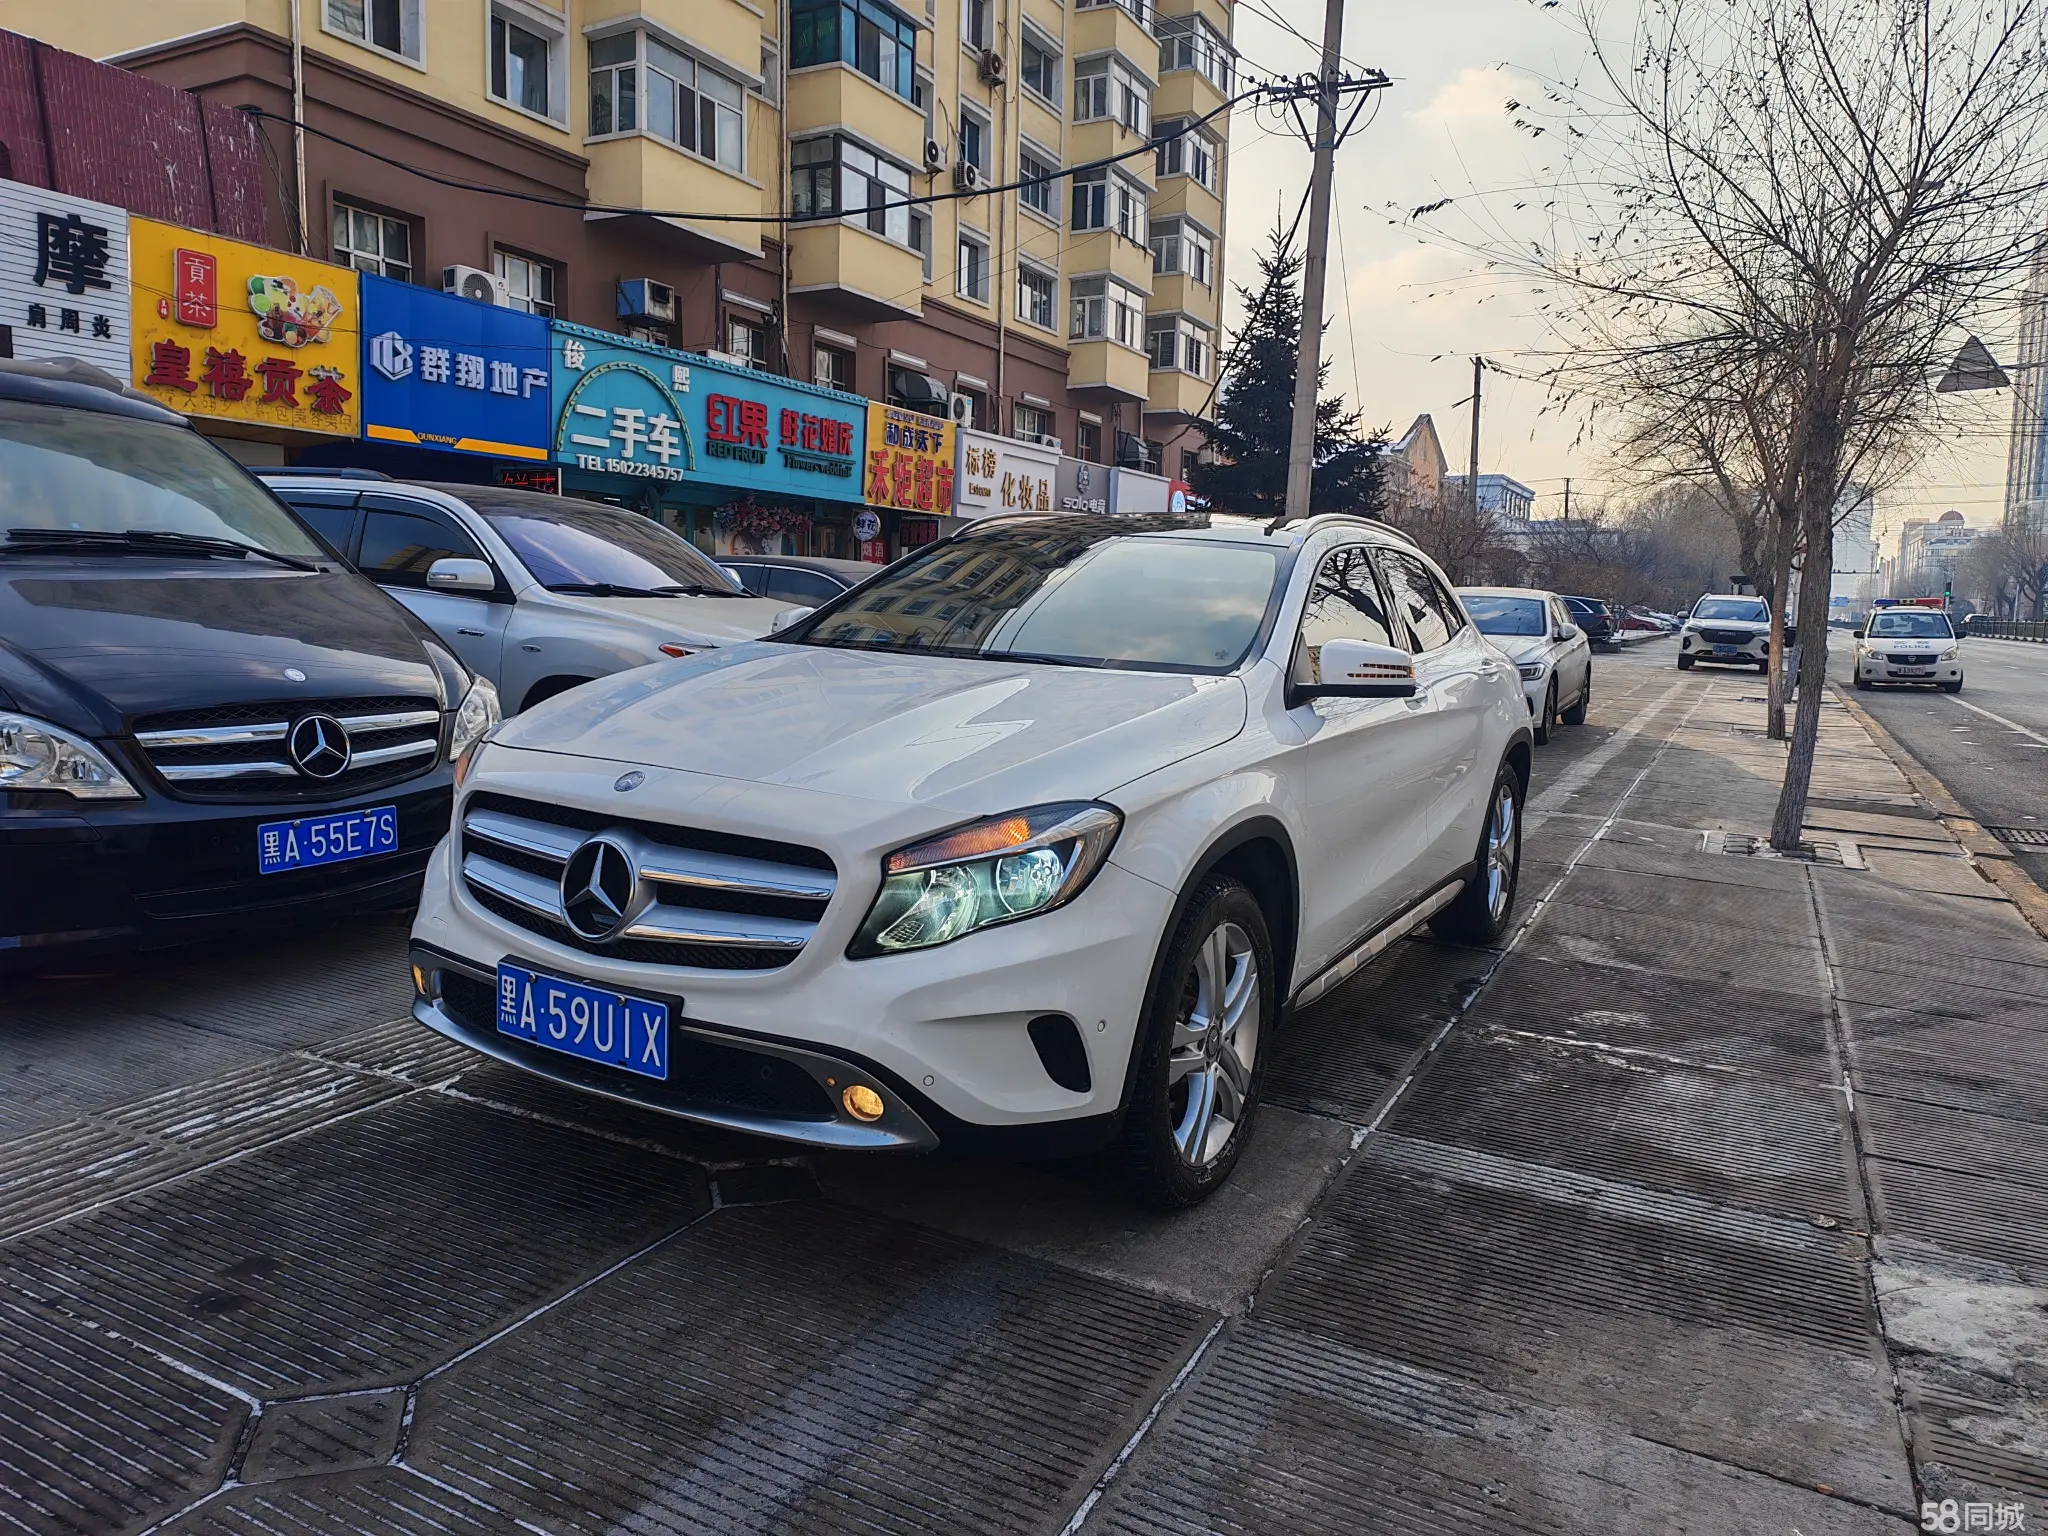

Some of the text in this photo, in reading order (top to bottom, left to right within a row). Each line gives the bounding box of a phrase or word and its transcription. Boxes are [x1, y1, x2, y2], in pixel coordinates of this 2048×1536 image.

[33, 212, 111, 294] 摩
[183, 257, 212, 319] 貢茶
[27, 303, 111, 339] 肩周炎
[144, 339, 352, 415] 皇禧贡茶
[420, 346, 548, 398] 群翔地产
[417, 432, 457, 445] QUNXIANG
[570, 403, 681, 464] 二手车
[707, 393, 769, 449] 红果
[780, 408, 854, 455] 鲜花婚庆
[576, 453, 684, 482] TEL 15022345757
[706, 441, 768, 465] RED FRUIT
[965, 444, 997, 479] 标榜
[1000, 471, 1049, 512] 化妆品
[264, 814, 394, 865] 黑A·55E7S
